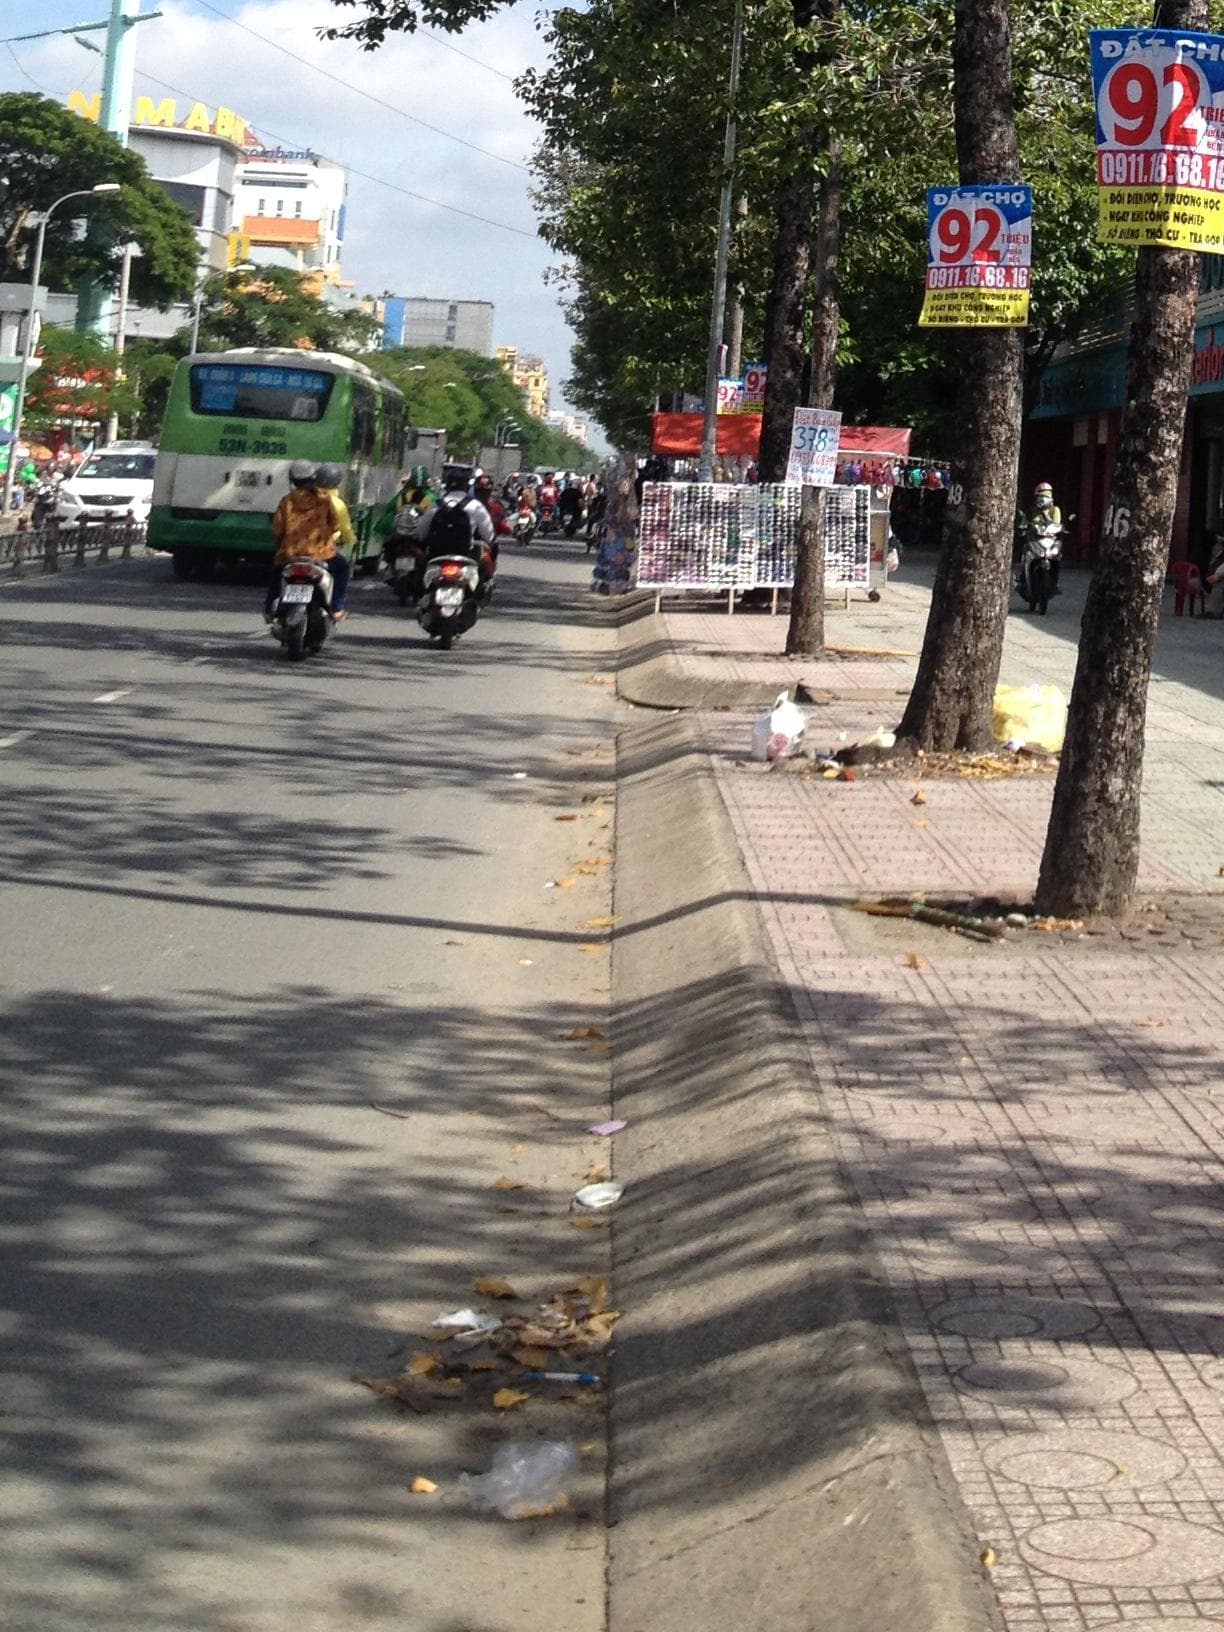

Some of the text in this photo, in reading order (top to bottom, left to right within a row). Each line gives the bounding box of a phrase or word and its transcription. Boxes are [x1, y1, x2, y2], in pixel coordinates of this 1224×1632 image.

[1108, 62, 1201, 147] 92
[937, 207, 1001, 264] 92
[717, 386, 737, 402] 92
[794, 426, 828, 453] 378
[1104, 504, 1131, 537] 16
